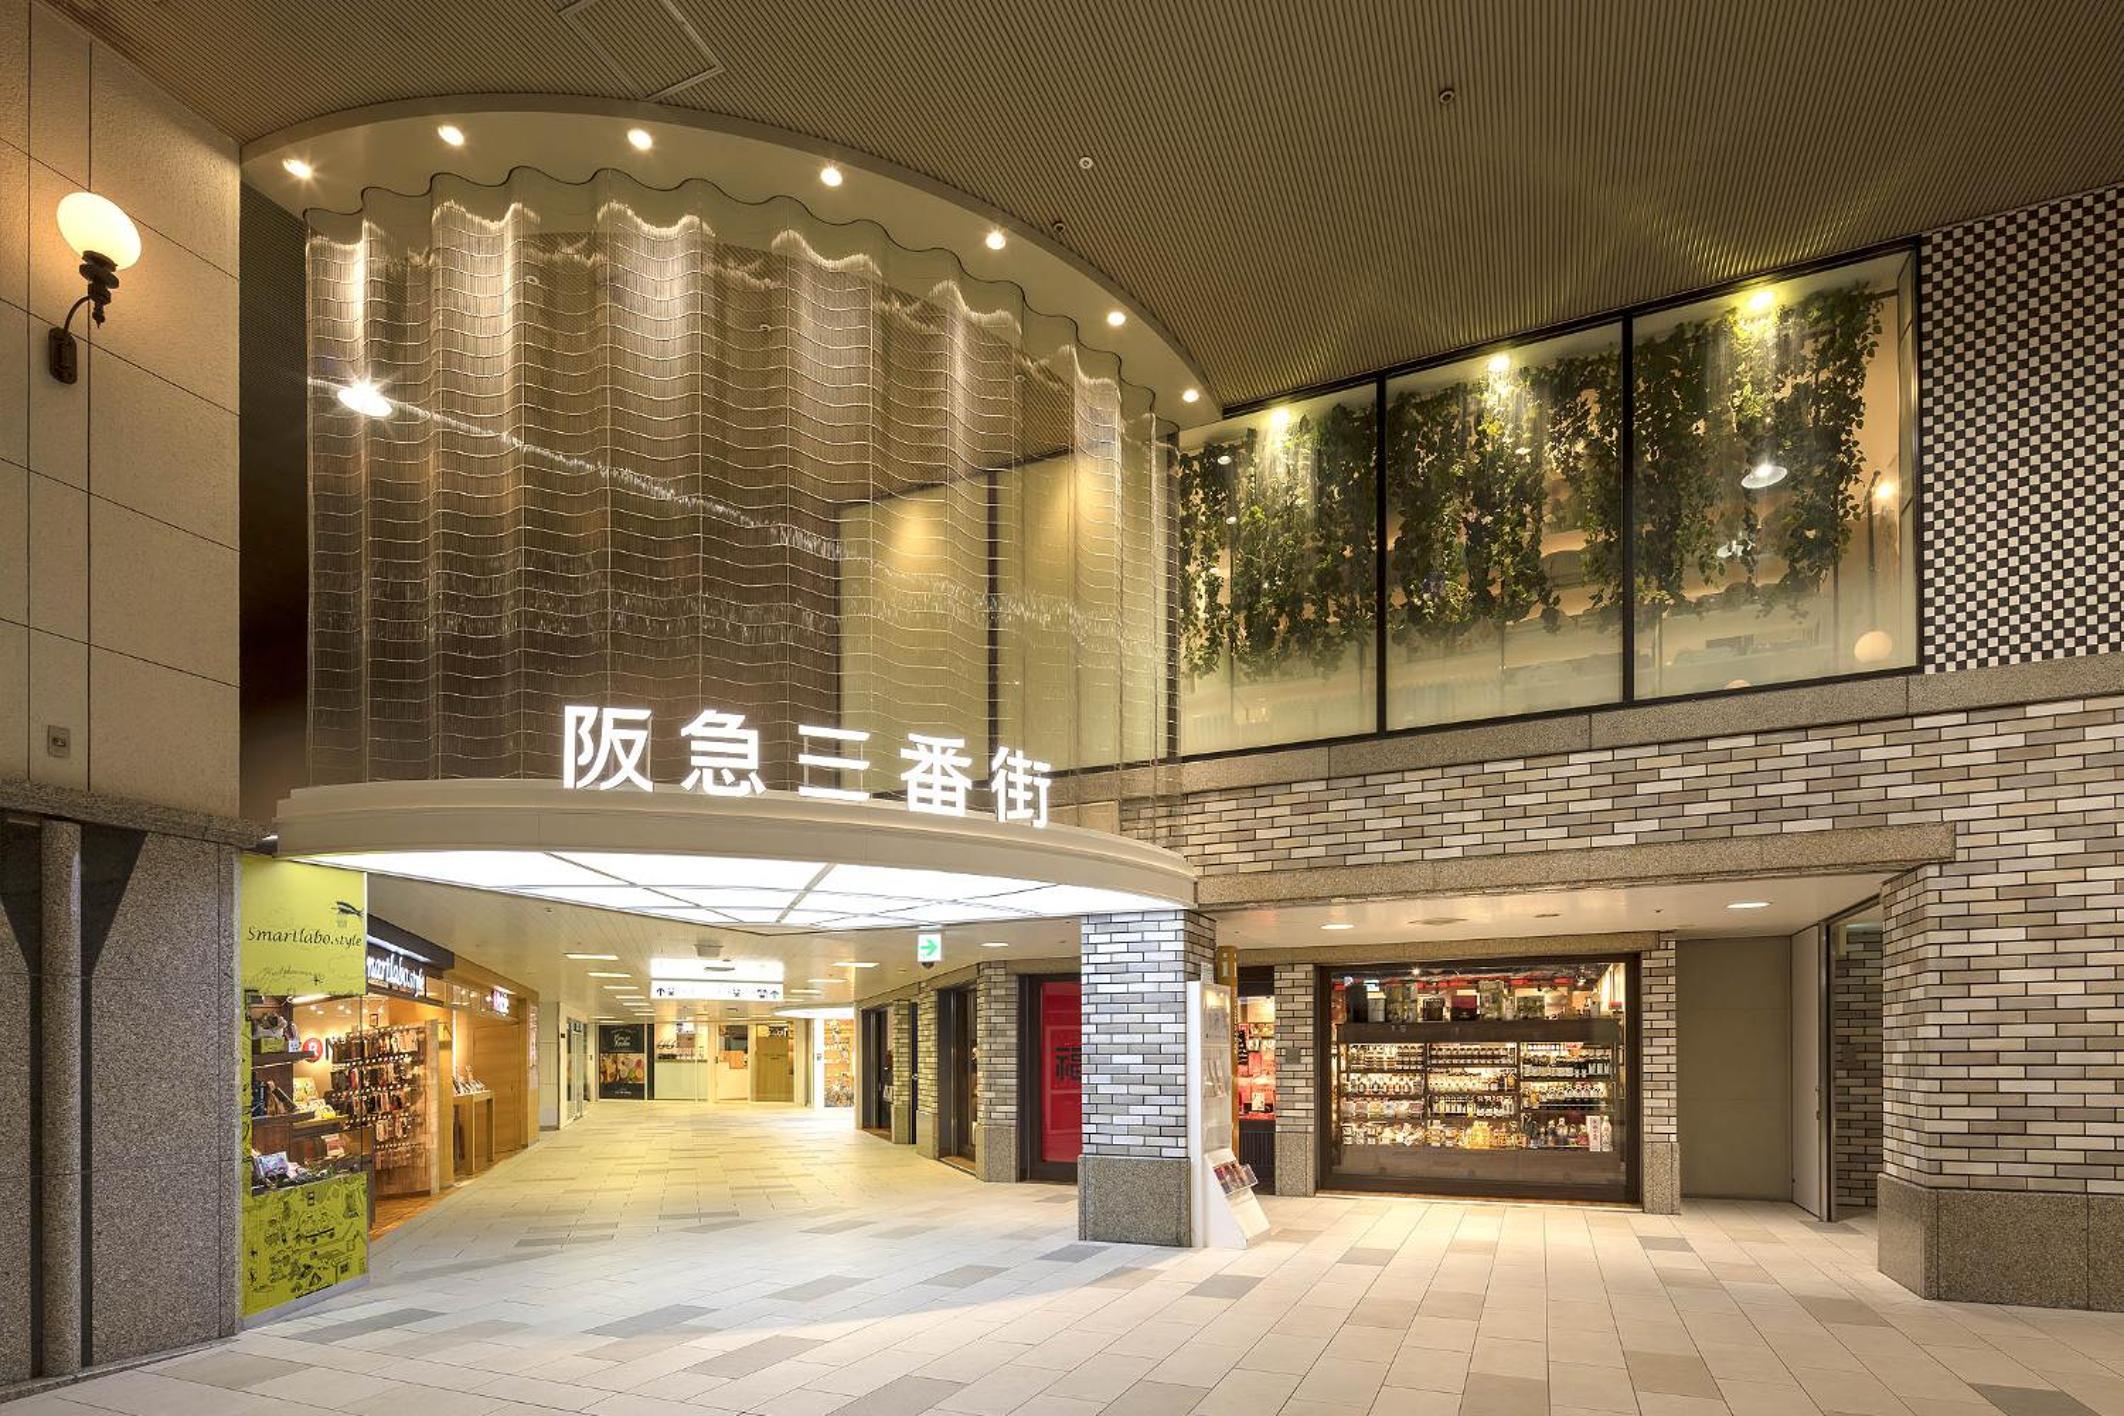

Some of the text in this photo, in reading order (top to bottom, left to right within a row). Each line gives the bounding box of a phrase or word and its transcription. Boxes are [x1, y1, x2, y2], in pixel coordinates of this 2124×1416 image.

[561, 704, 1053, 828] 阪急三番街
[247, 926, 362, 949] Smartlabo.style
